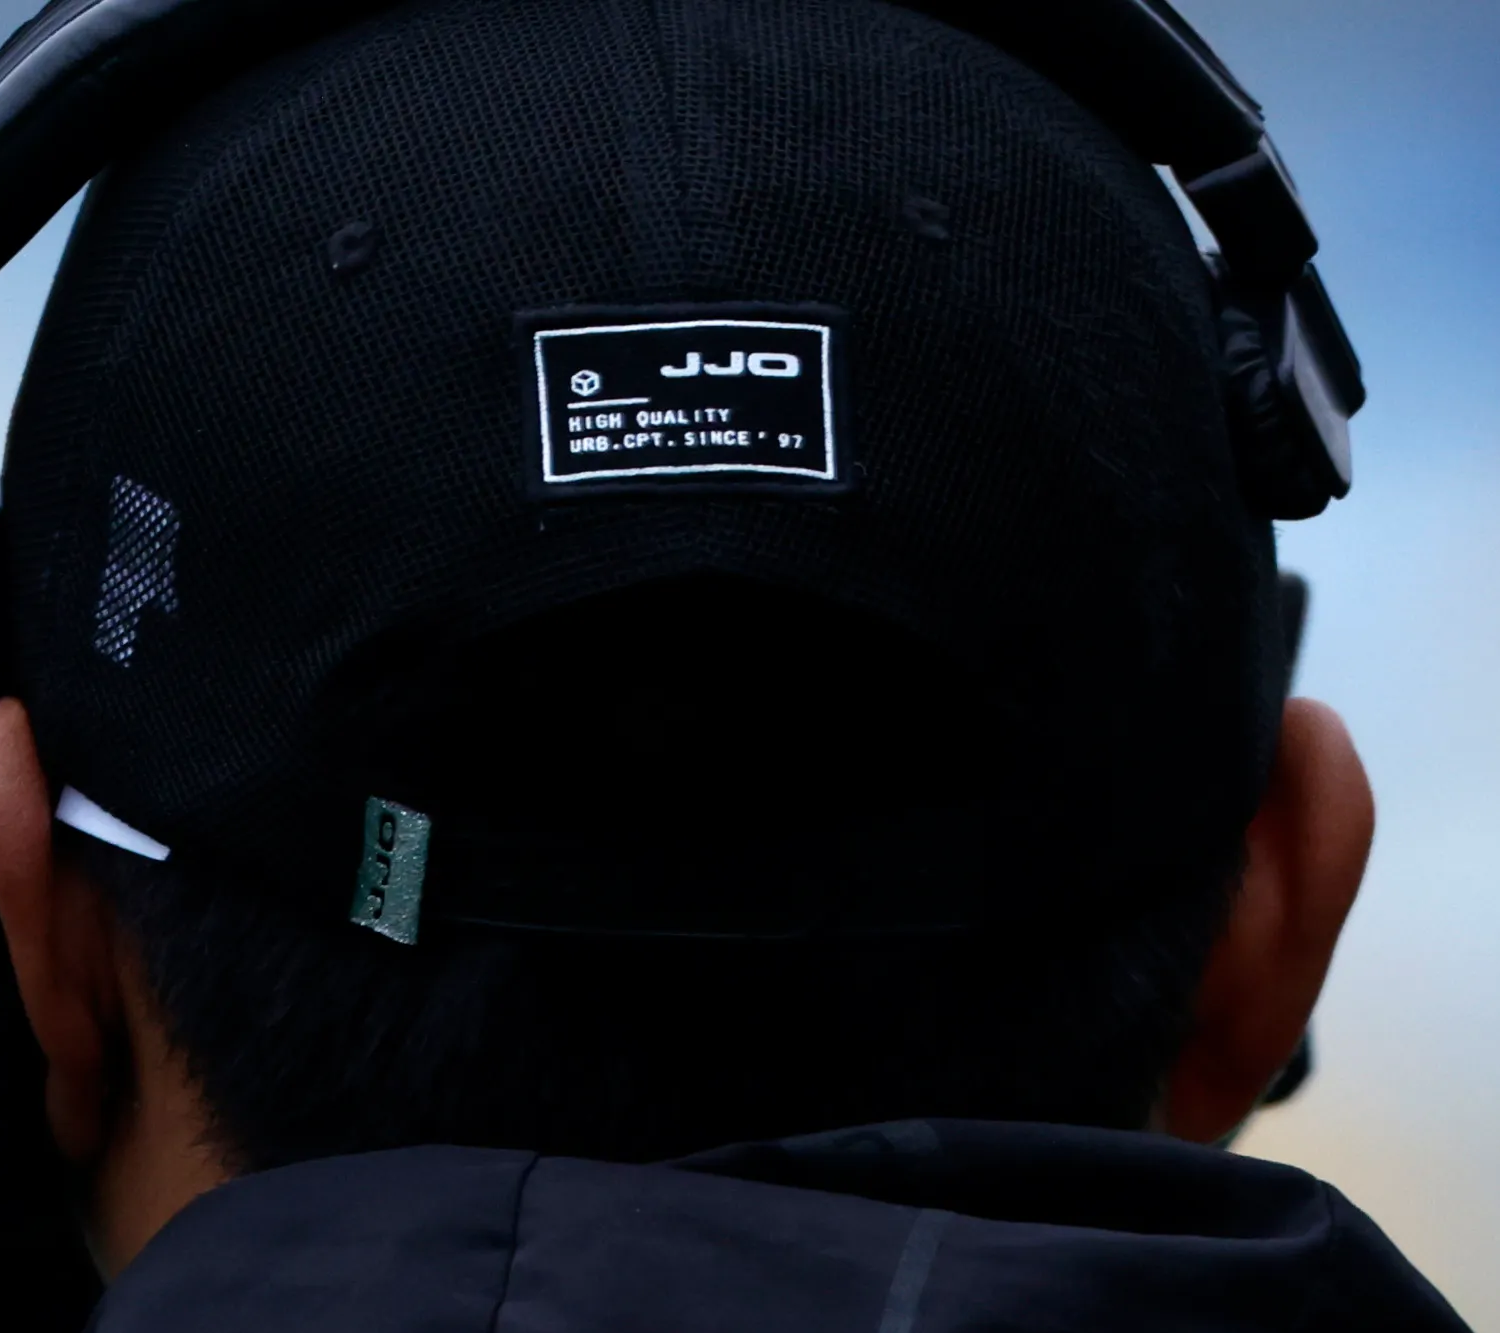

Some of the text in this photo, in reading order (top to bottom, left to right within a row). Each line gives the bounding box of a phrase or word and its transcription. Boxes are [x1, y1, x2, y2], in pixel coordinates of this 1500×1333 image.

[659, 351, 800, 378] JJO
[568, 407, 731, 433] HIGH QUALITY
